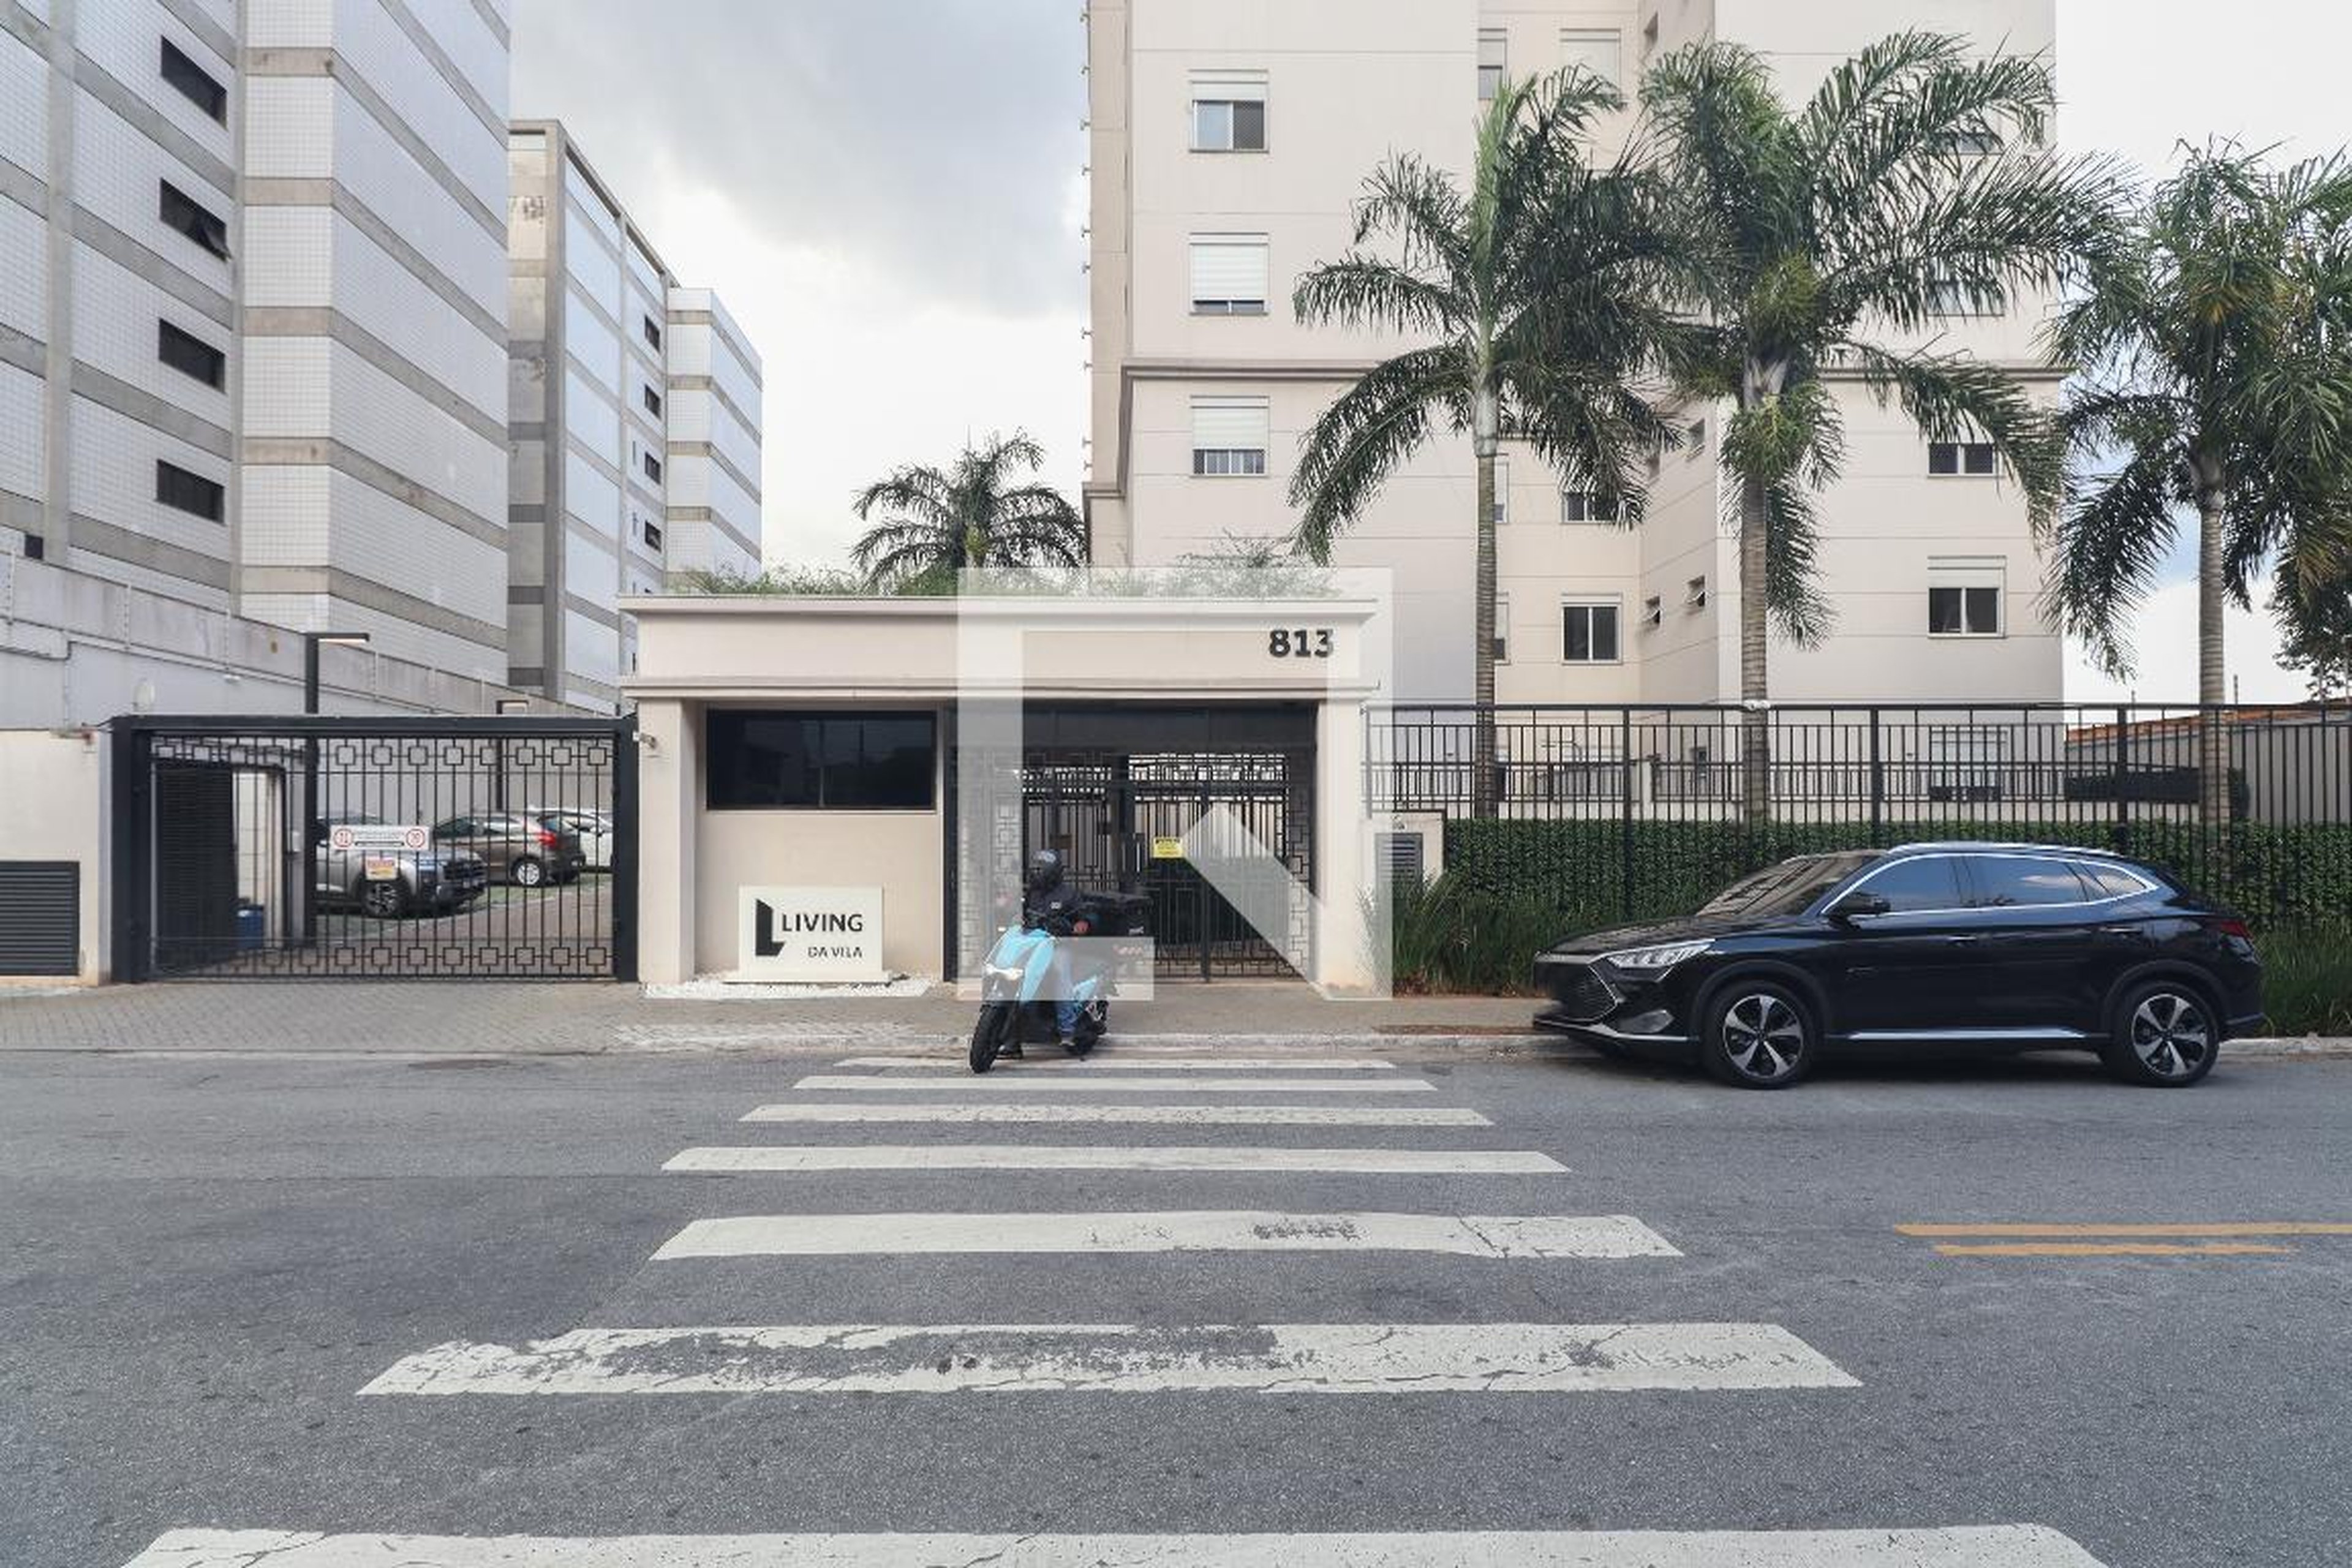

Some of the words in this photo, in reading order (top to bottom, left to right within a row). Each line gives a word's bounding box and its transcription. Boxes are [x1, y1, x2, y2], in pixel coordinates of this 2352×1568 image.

[1269, 630, 1333, 658] 813
[782, 913, 863, 932] LIVING
[808, 947, 827, 958] DA
[832, 947, 862, 958] VILA
